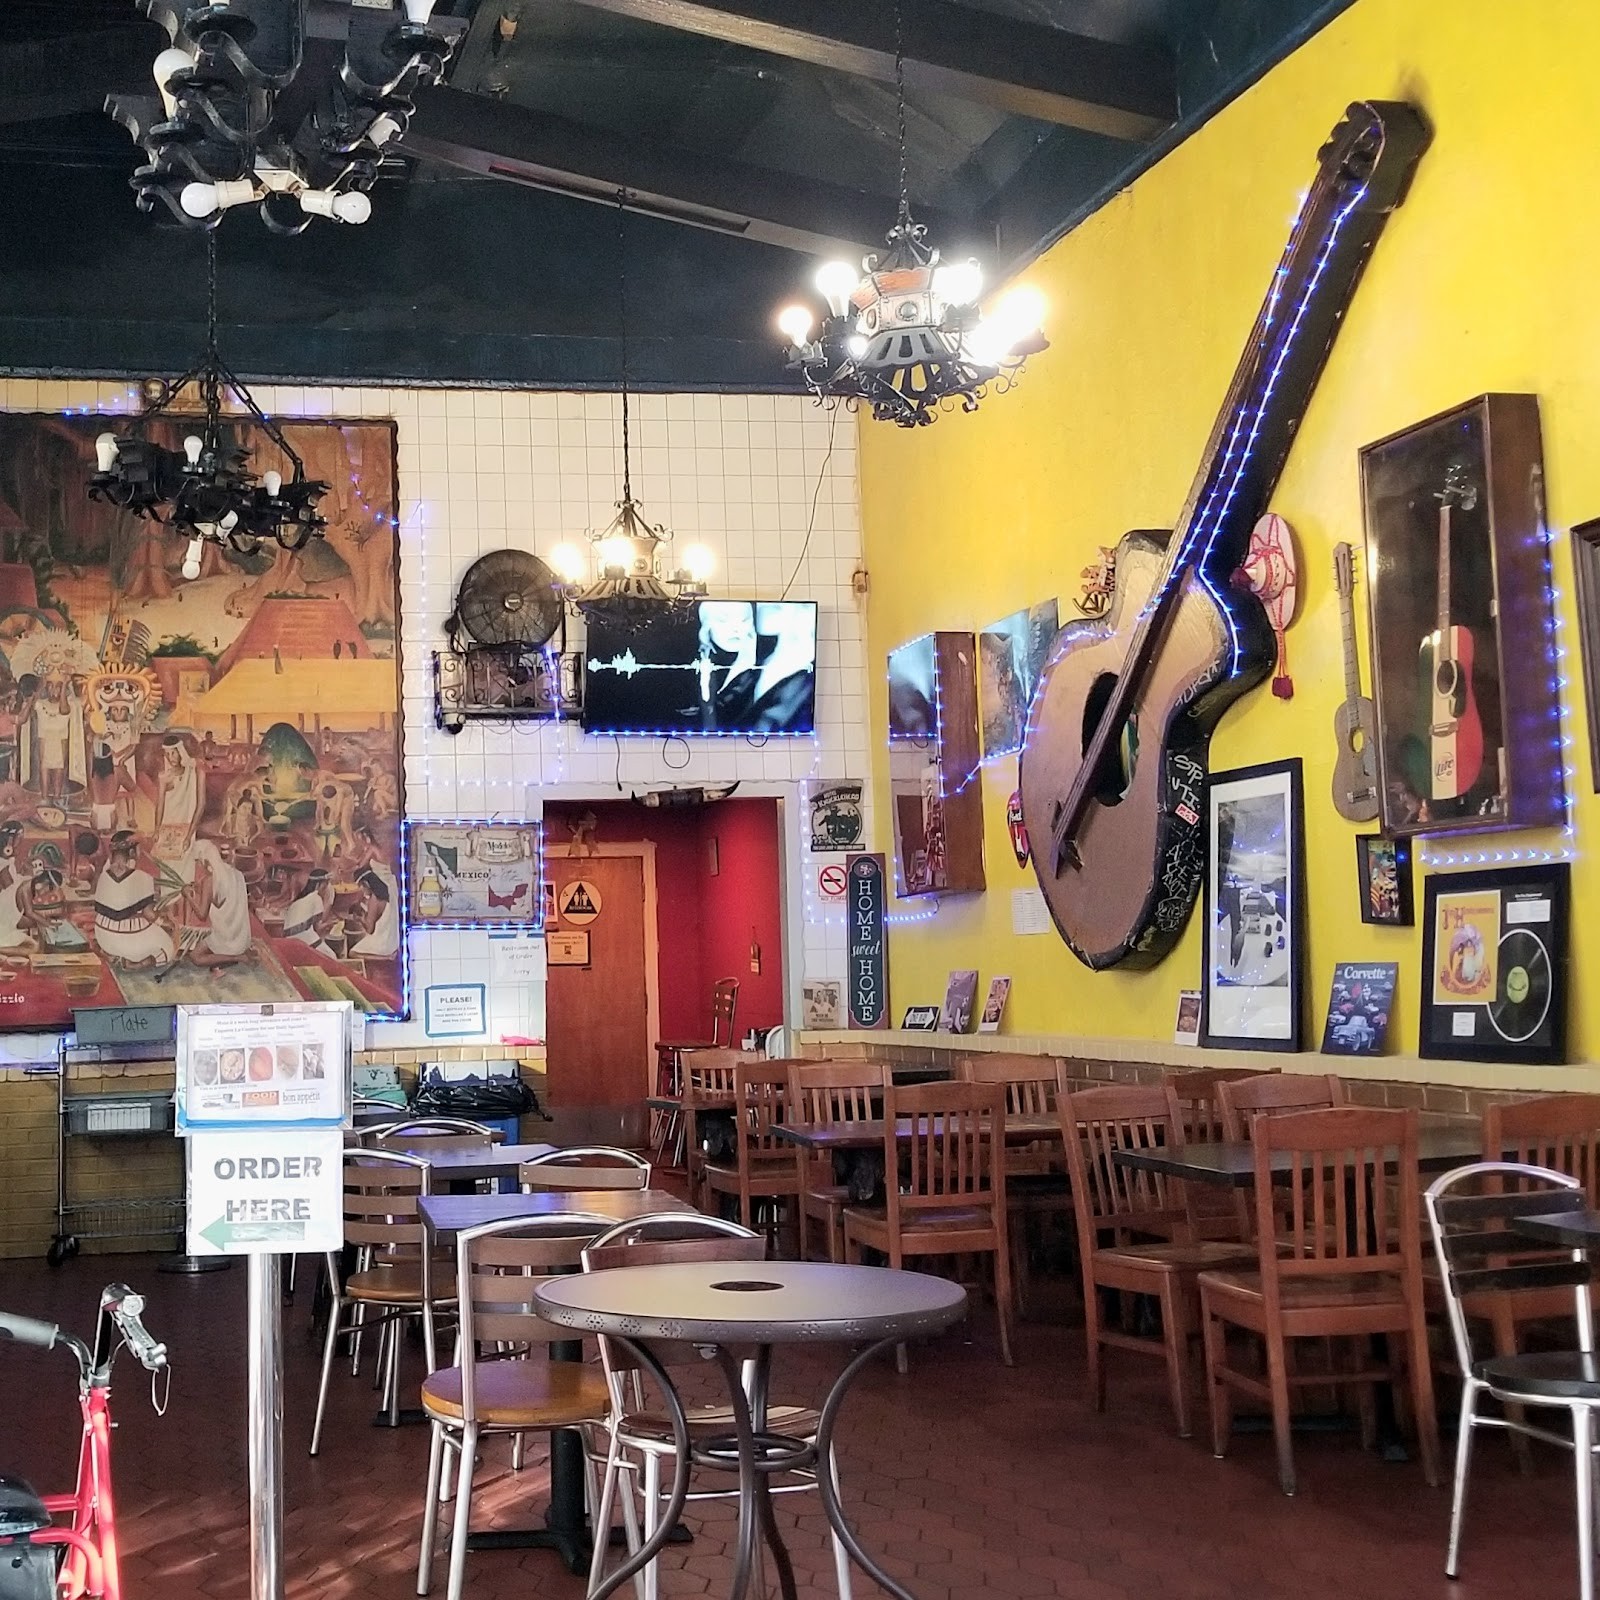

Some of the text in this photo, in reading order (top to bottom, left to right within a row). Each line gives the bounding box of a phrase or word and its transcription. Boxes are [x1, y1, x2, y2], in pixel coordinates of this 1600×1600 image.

[856, 880, 875, 940] HOME
[852, 941, 881, 957] sweet
[1344, 966, 1386, 980] Corvette
[440, 996, 472, 1004] PLEASE!
[857, 960, 876, 1021] HOME
[214, 1157, 322, 1180] ORDER
[226, 1198, 311, 1221] HERE
